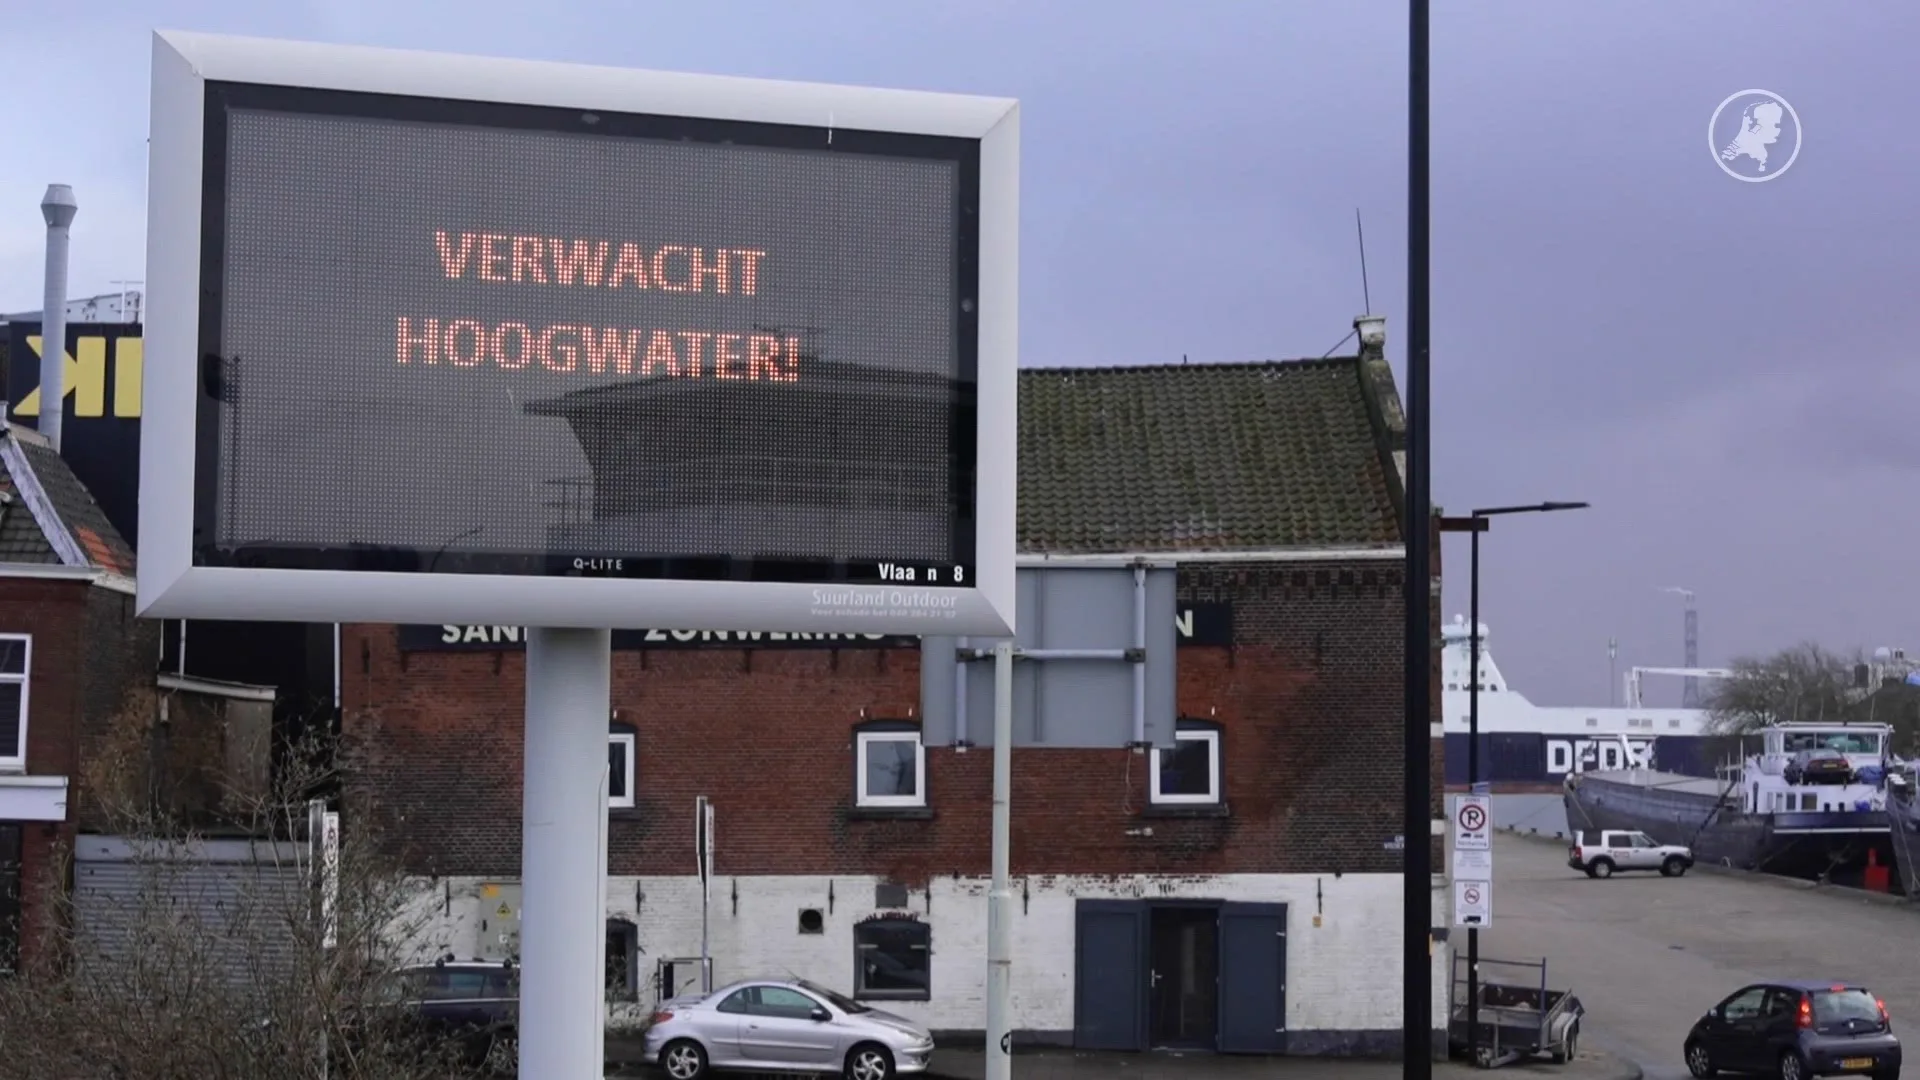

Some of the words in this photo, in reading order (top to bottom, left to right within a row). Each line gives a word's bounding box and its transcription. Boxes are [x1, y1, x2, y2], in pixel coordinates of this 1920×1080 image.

[435, 230, 766, 296] VERWACHT
[396, 316, 799, 382] HOOGWATER!
[573, 557, 623, 571] Q-LITE
[878, 562, 915, 581] Vlaa
[953, 565, 964, 582] 8
[812, 588, 885, 606] Suurland
[890, 590, 958, 608] Outdoor
[441, 624, 528, 643] SAN
